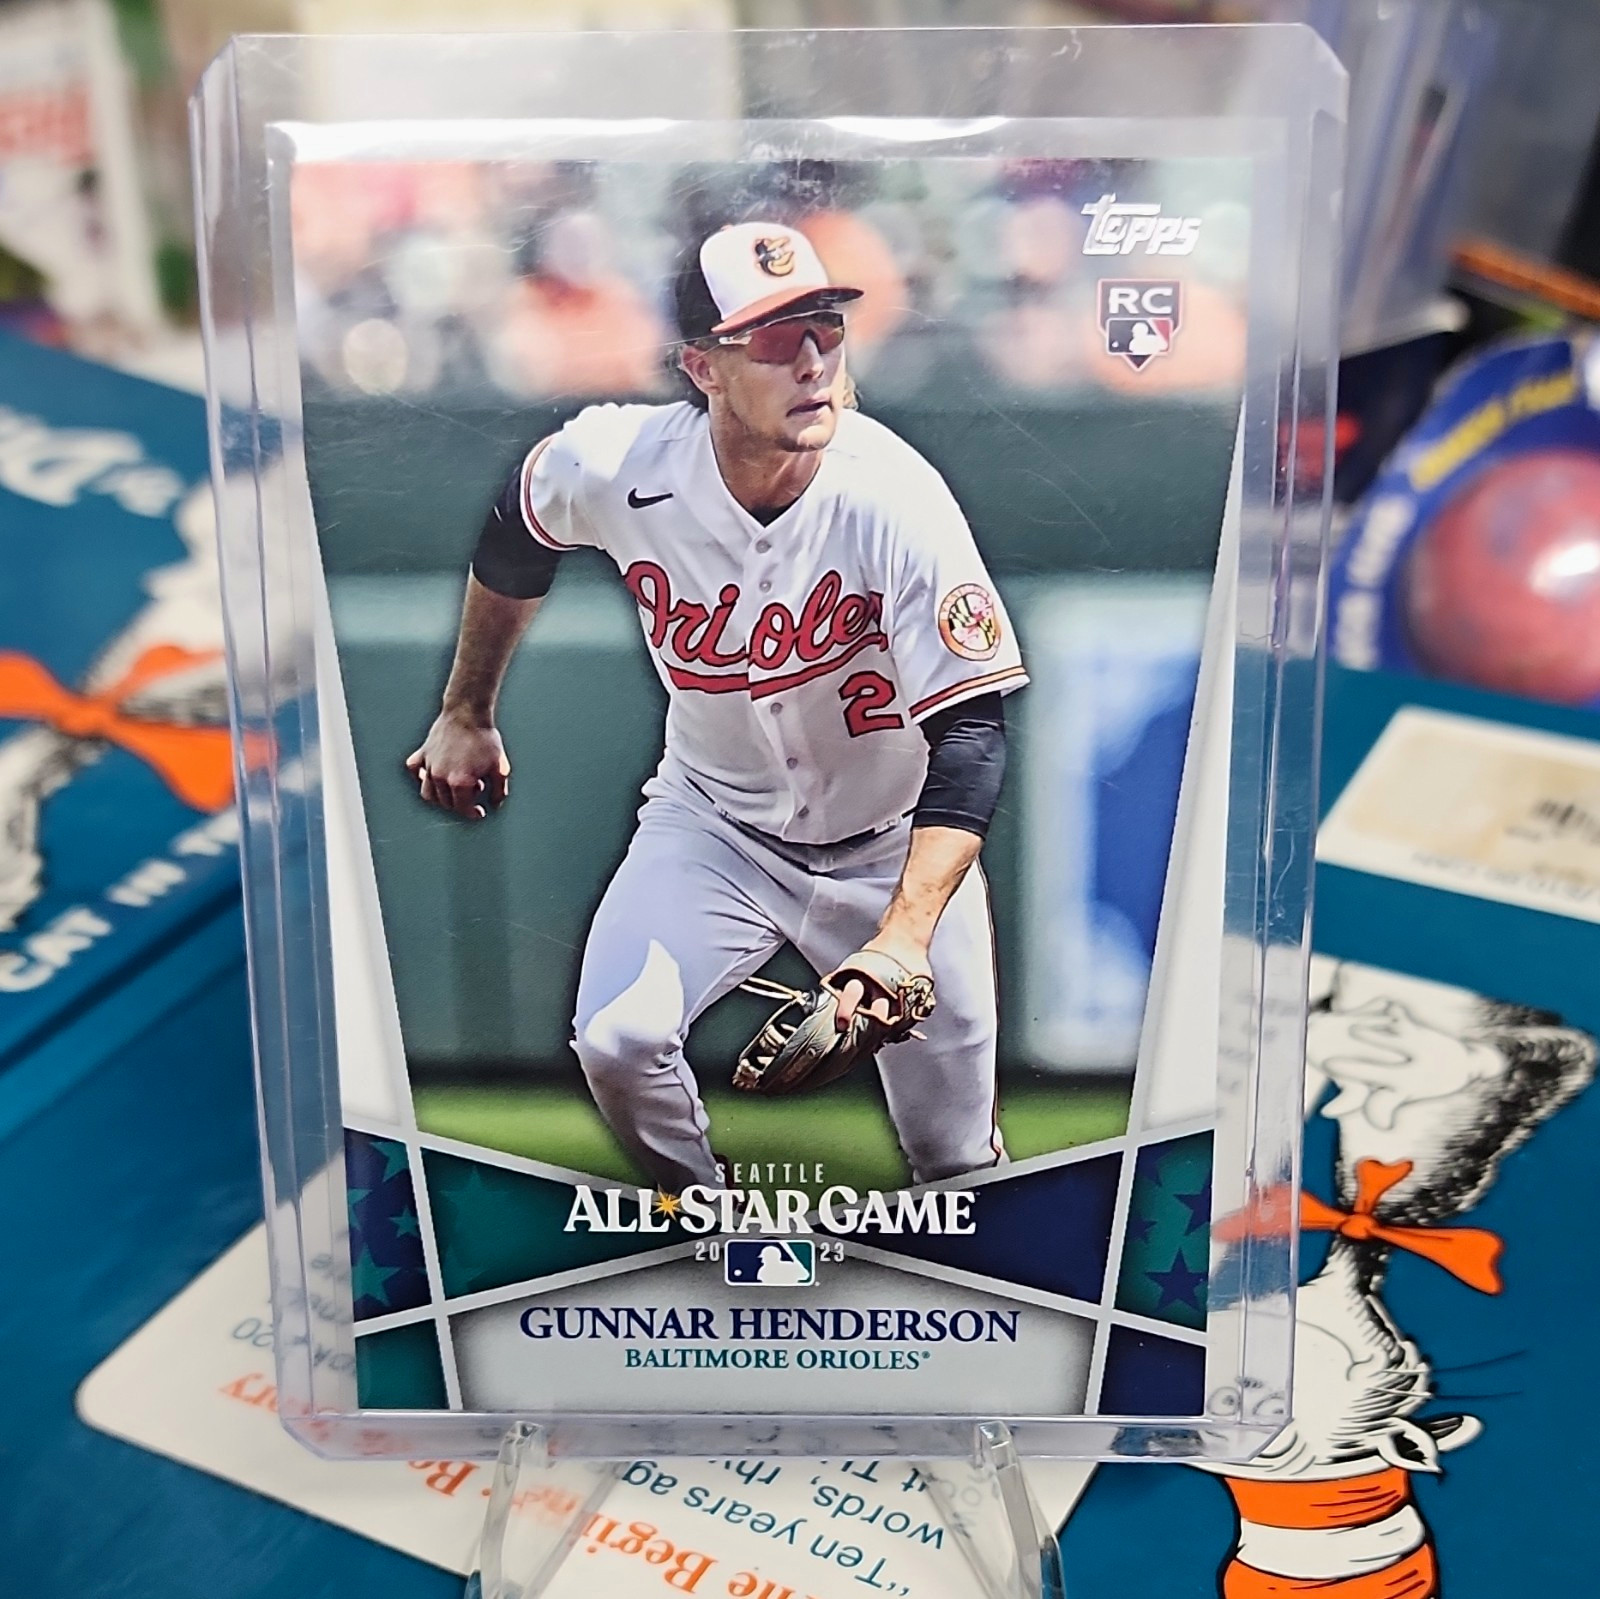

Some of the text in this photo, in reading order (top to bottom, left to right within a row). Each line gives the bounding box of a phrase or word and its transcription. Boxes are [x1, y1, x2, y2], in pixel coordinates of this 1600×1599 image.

[1108, 287, 1173, 314] RC
[838, 671, 905, 738] 2
[714, 1162, 825, 1184] SEATTLE
[563, 1184, 977, 1235] ALL STAR GAME
[694, 1241, 845, 1263] 20 23
[519, 1306, 1022, 1343] GUNNAR HENDERSON
[624, 1348, 790, 1369] BALTIMORE
[590, 1460, 689, 1496] ag
[683, 1486, 808, 1545] years
[810, 1475, 945, 1550] words,
